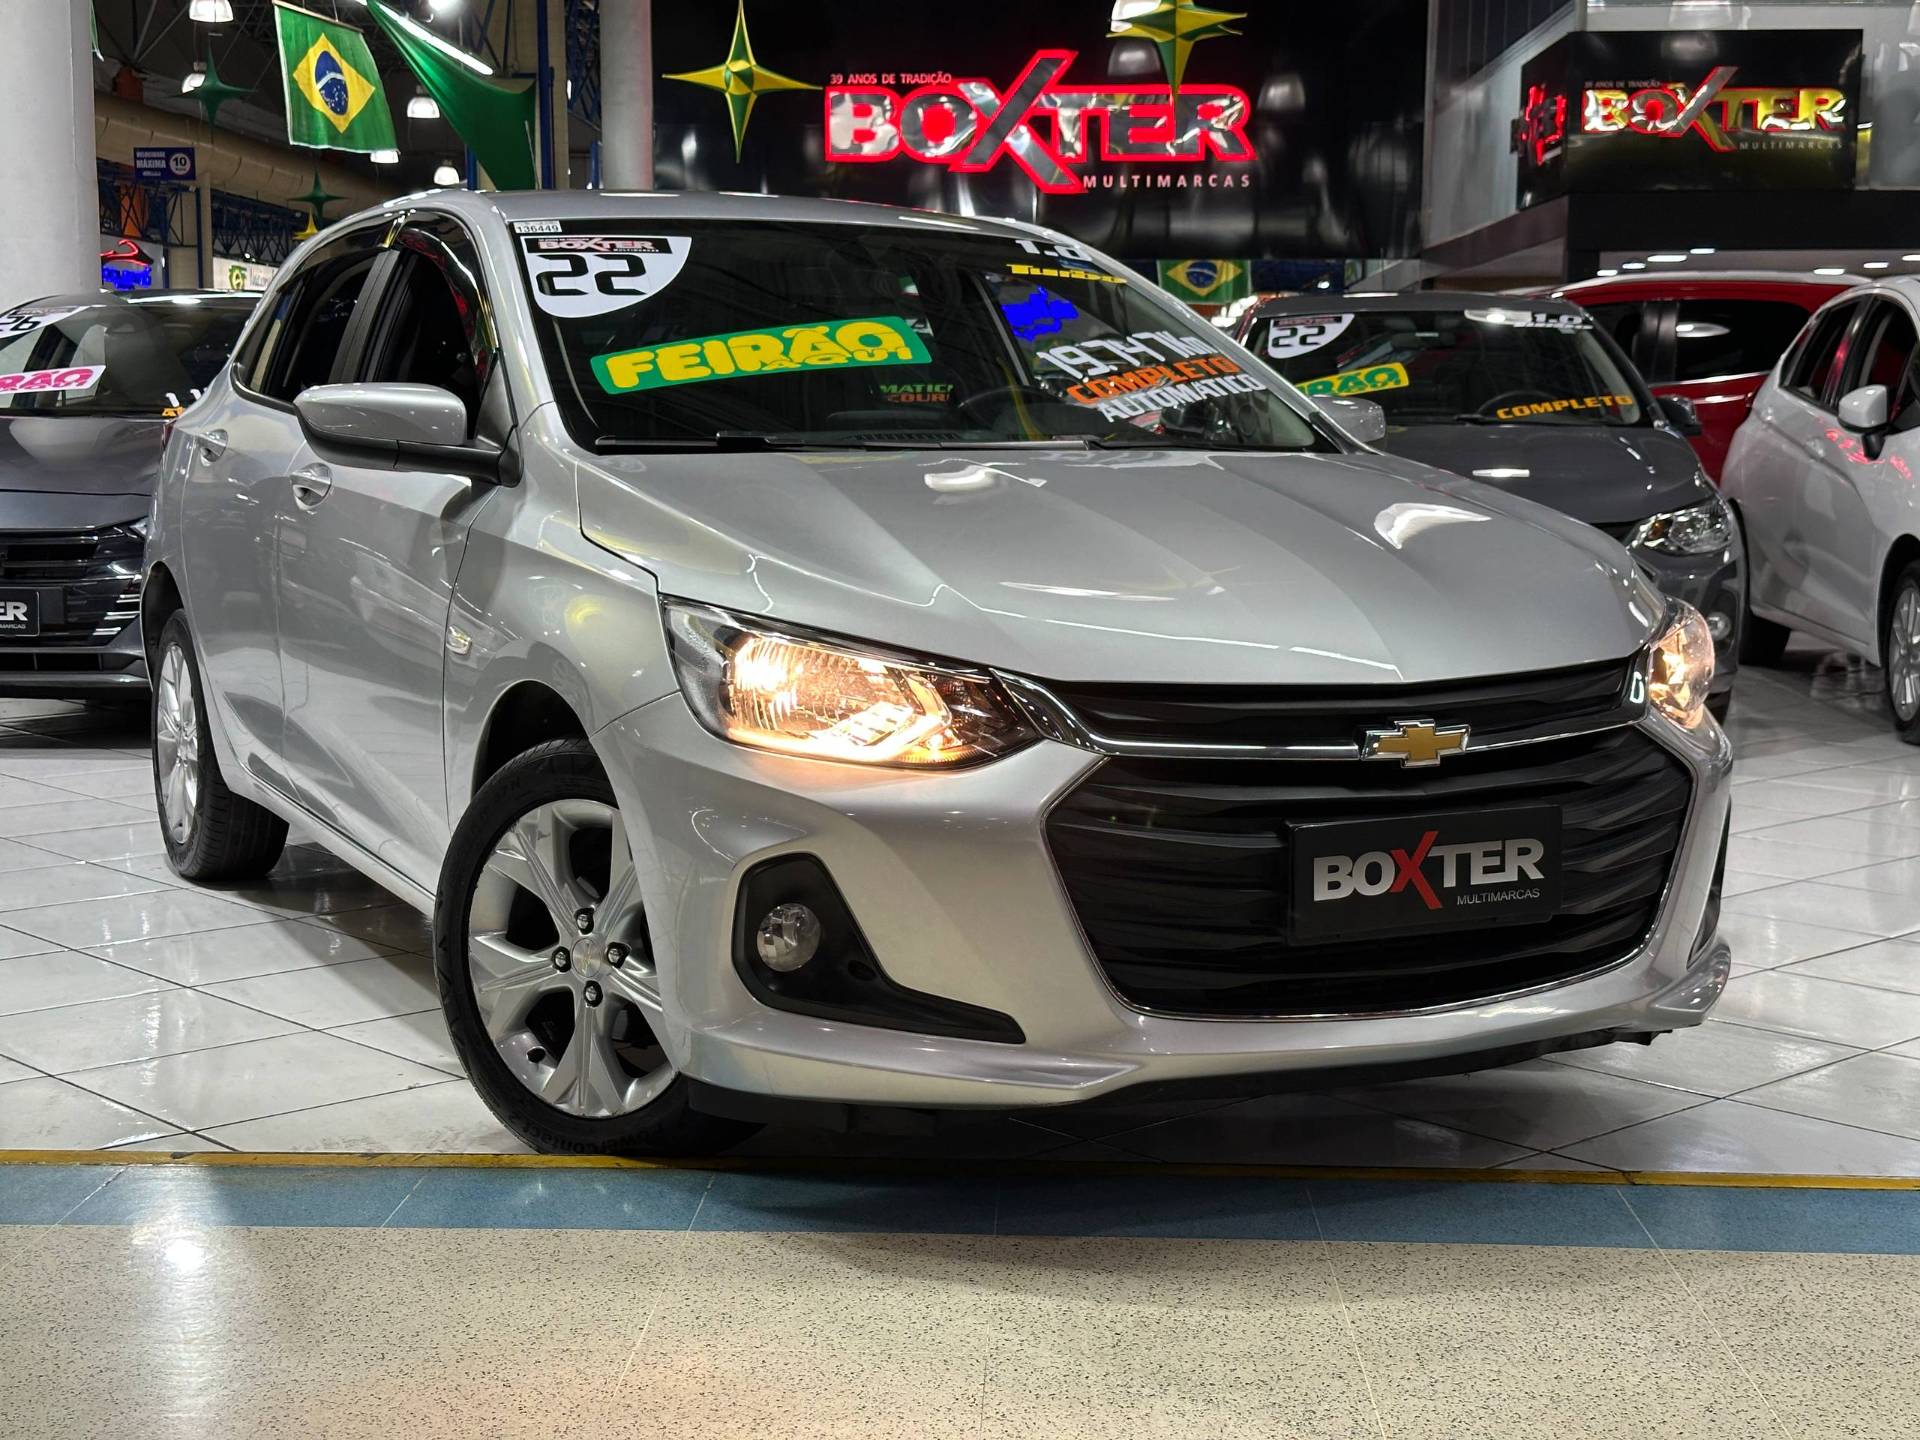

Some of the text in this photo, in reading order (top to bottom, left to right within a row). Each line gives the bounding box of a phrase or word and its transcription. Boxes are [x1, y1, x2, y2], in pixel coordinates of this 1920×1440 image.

[830, 71, 951, 86] 39 ANOS DE TRADIÇÃO
[1582, 66, 1847, 152] BOXTER
[825, 49, 1258, 193] BOXTER
[1739, 141, 1842, 150] MULTIMARCAS
[136, 158, 167, 169] MÁXIMA
[172, 156, 188, 167] 10
[1083, 174, 1250, 188] MULTIMARCAS
[516, 225, 560, 233] 136449
[538, 237, 655, 252] BOXTER
[536, 254, 647, 296] 22
[1271, 325, 1326, 348] 22
[606, 321, 907, 388] FEIRÃO
[762, 347, 913, 371] AQUI
[1066, 355, 1240, 404] COMPLETO
[1496, 395, 1633, 419] COMPLETO
[1313, 830, 1545, 910] BOXTER
[1456, 887, 1541, 906] MULTIMARCAS
